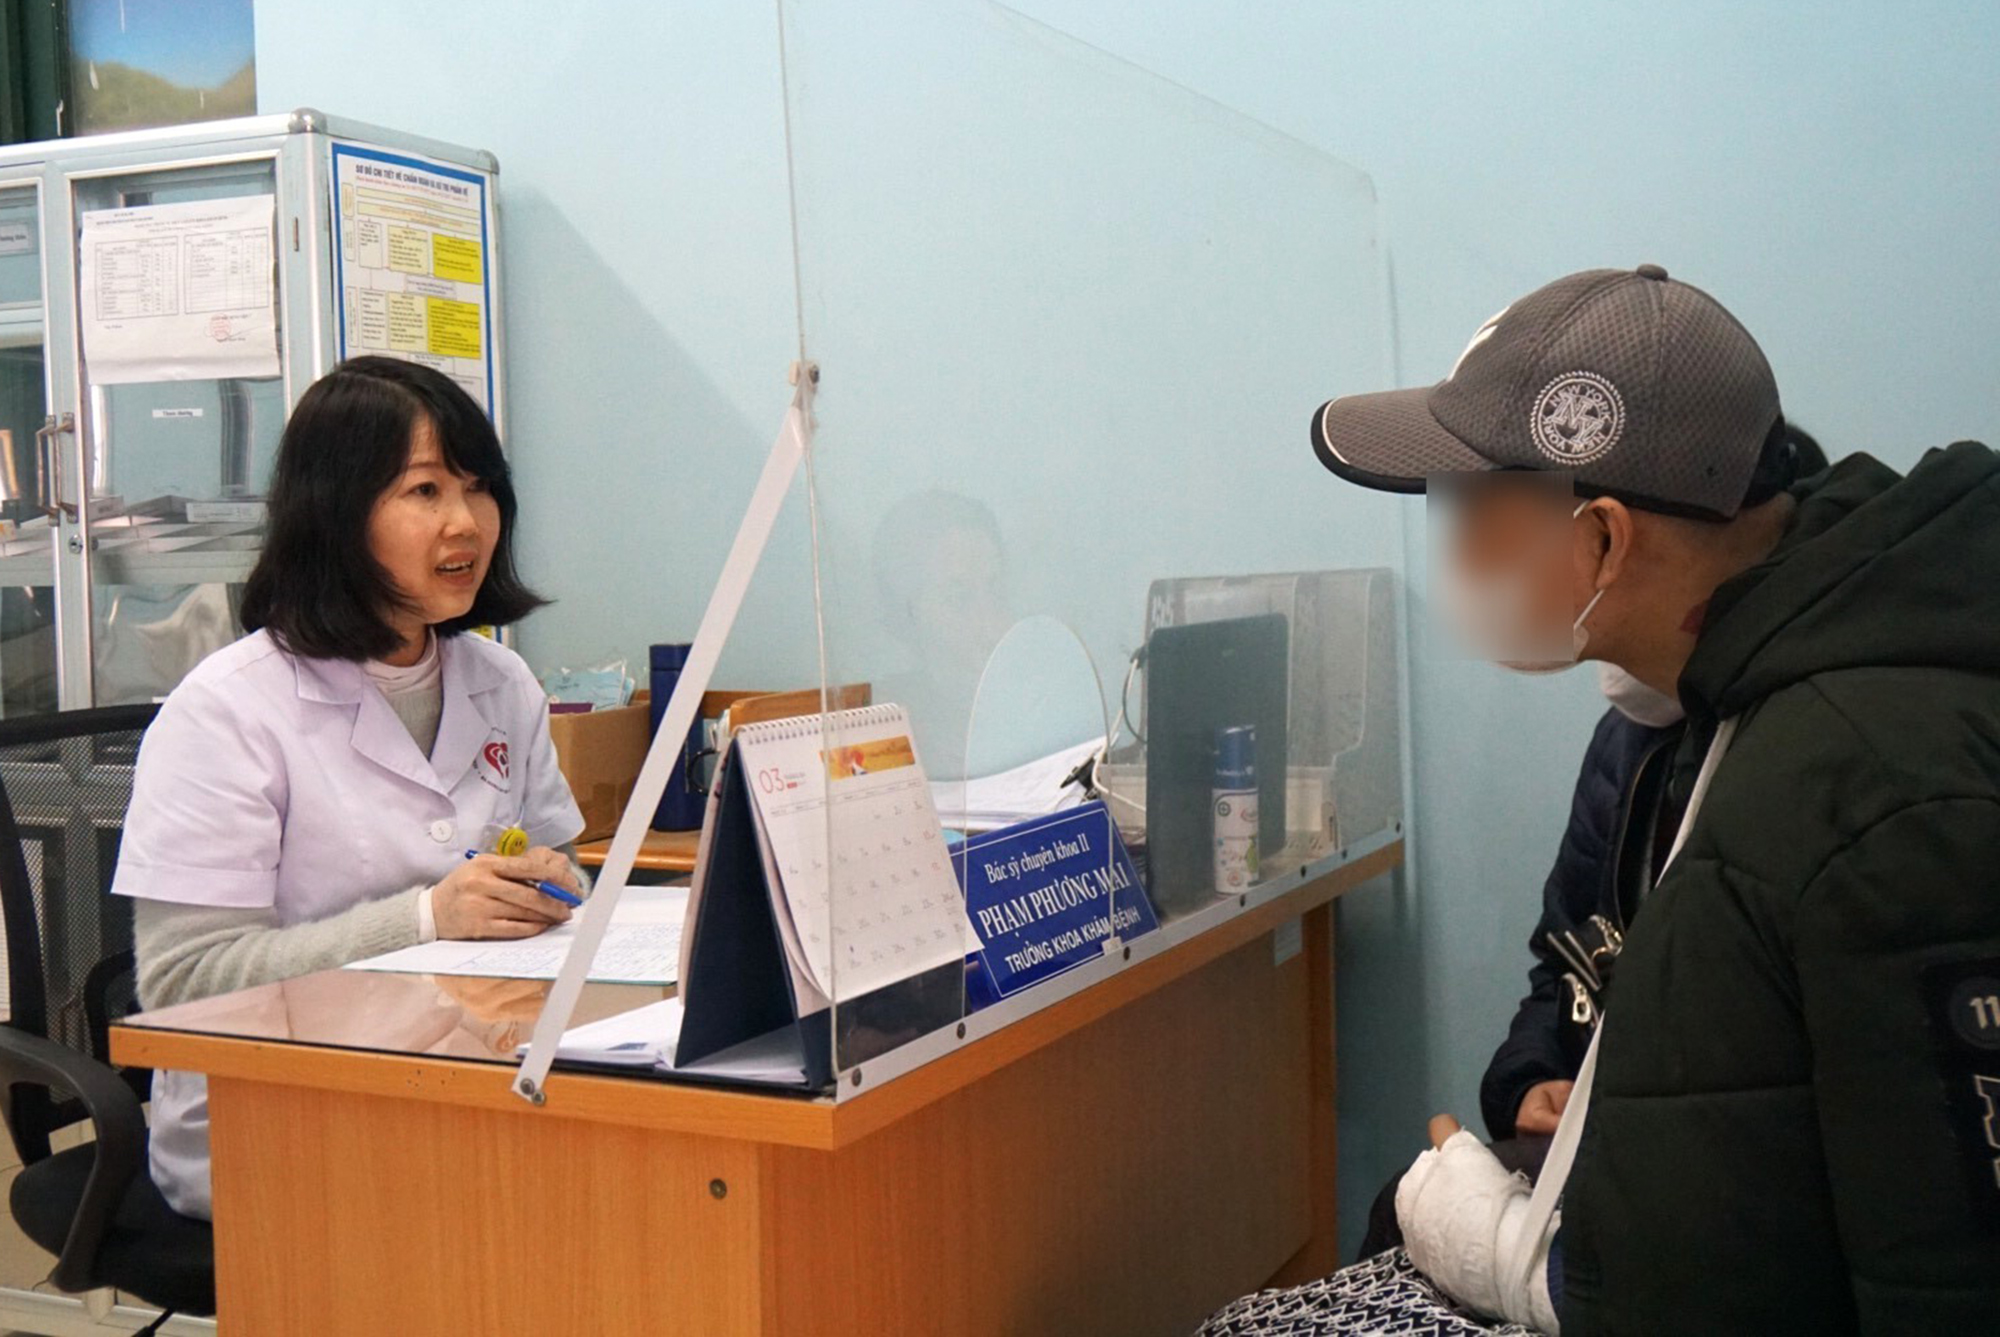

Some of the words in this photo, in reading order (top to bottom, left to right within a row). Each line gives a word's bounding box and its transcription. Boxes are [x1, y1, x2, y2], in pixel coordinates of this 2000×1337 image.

[1549, 384, 1581, 407] NEW
[1582, 385, 1613, 424] YORK
[1541, 413, 1566, 451] YORK
[759, 768, 785, 794] 03
[985, 862, 1008, 884] Bác
[1020, 847, 1055, 872] chuyên
[1053, 839, 1079, 860] khoa
[977, 896, 1035, 939] PHẠM
[1029, 872, 1098, 919] PHƯƠNG
[1093, 862, 1131, 895] MAI
[1004, 941, 1054, 974] TRƯỞNG
[1051, 931, 1084, 955] KHOA
[1081, 915, 1111, 942] KHÁM
[1113, 906, 1142, 932] BỆNH
